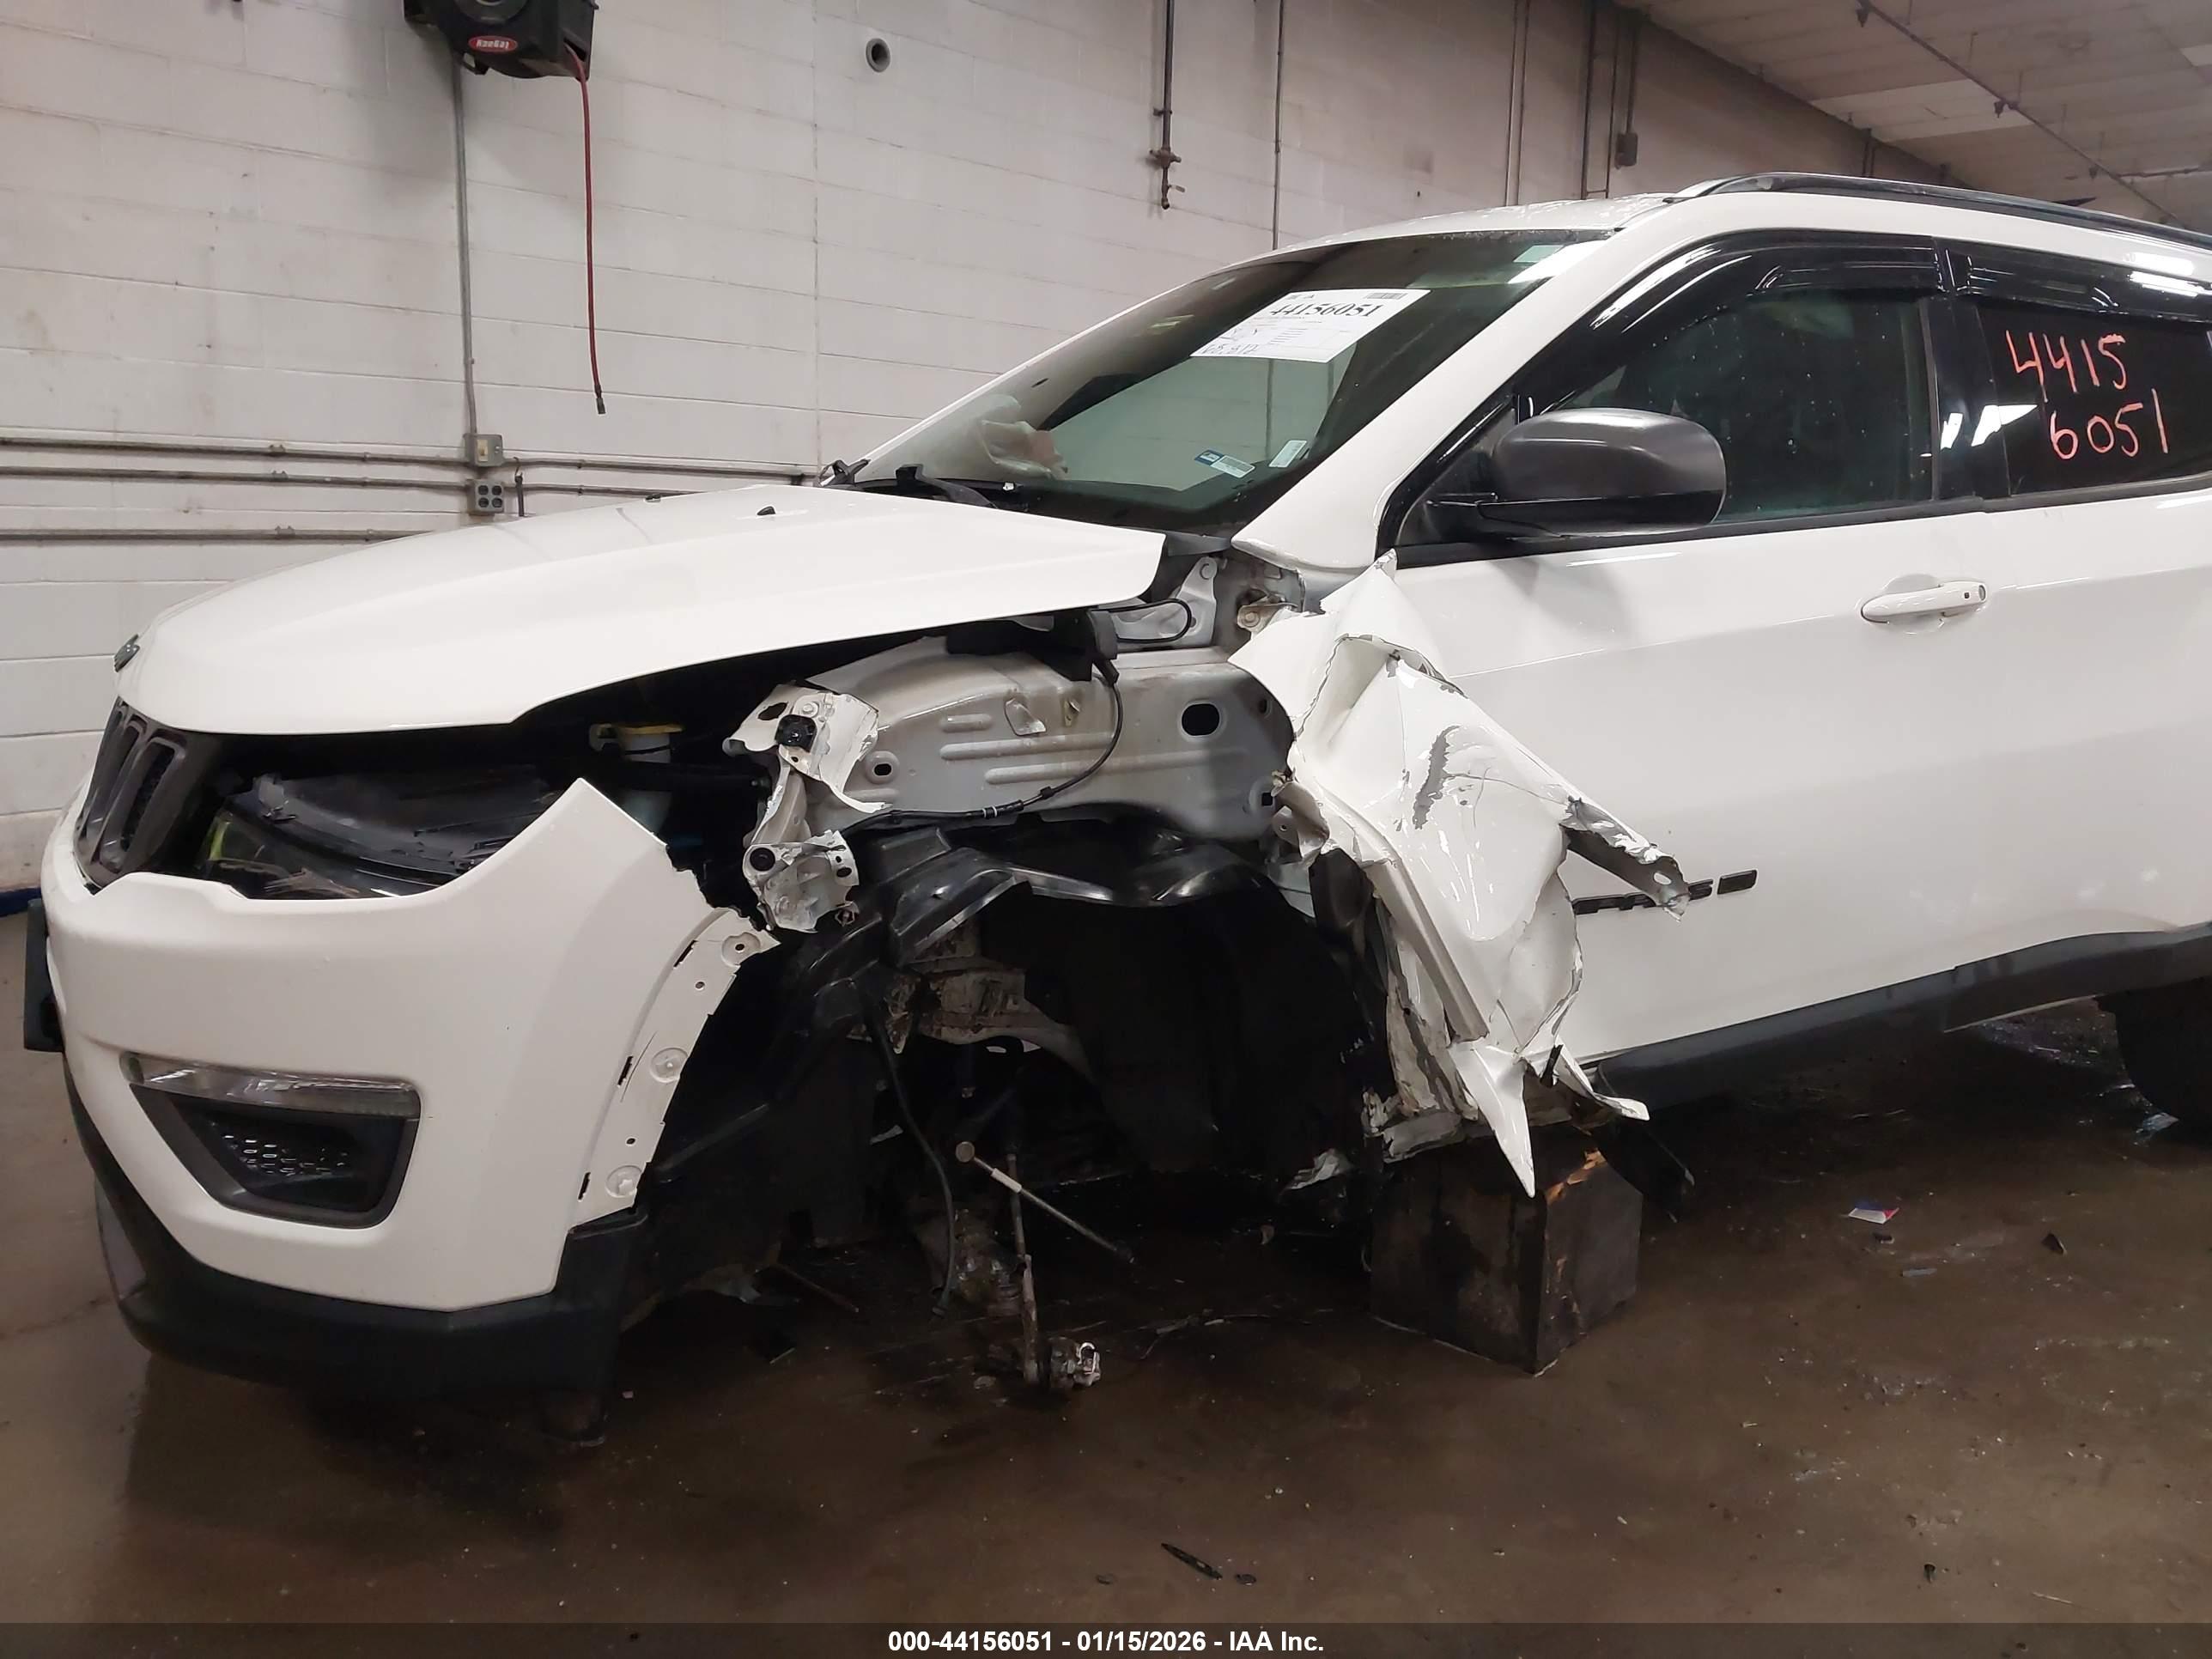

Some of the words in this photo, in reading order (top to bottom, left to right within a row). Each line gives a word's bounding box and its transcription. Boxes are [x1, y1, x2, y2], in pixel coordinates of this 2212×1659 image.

[1270, 303, 1384, 317] 44156051
[2004, 329, 2127, 404] 4415
[2049, 387, 2169, 460] 6051
